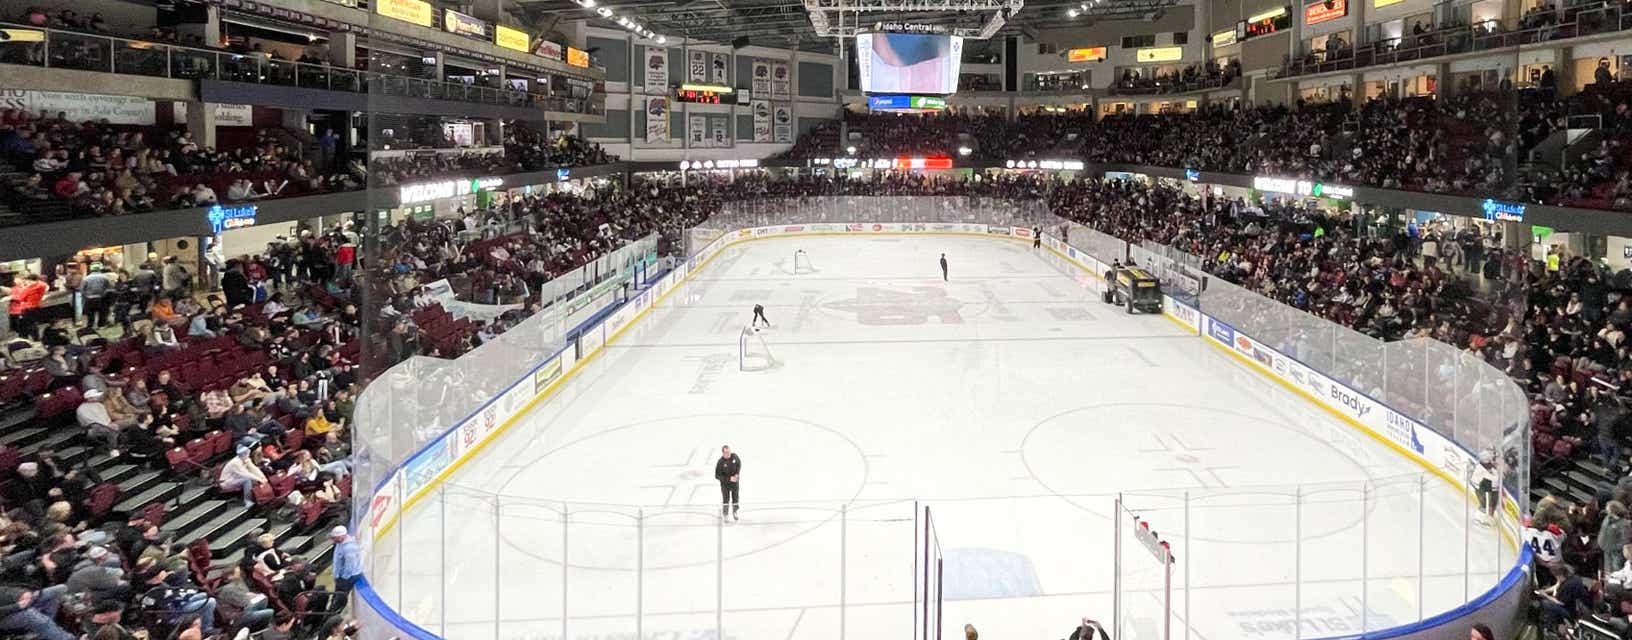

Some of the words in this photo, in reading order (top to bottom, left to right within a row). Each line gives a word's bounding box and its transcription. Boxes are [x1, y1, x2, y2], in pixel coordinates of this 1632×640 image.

[883, 23, 903, 31] Idaho
[904, 23, 932, 31] Central
[692, 64, 704, 76] 22
[401, 180, 455, 204] WELCOME
[1331, 384, 1365, 417] Brady
[1386, 410, 1410, 433] IDAHO
[1531, 536, 1556, 557] 44
